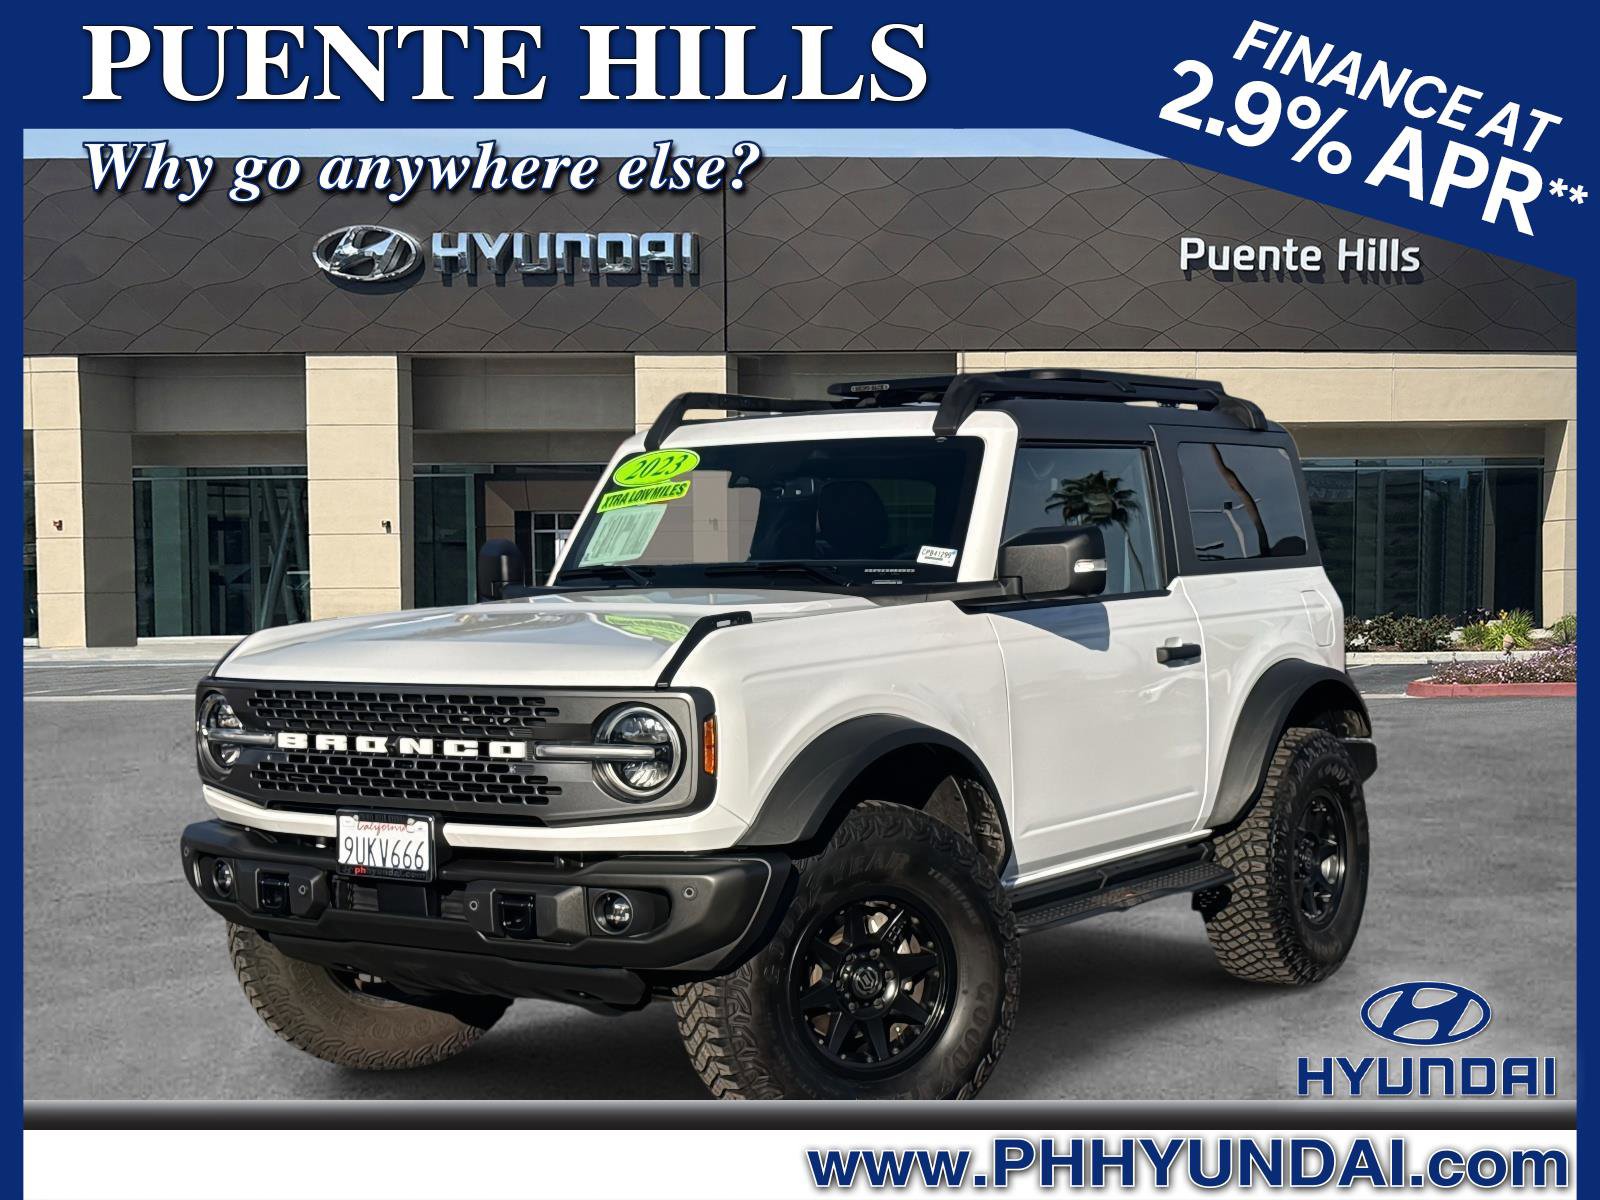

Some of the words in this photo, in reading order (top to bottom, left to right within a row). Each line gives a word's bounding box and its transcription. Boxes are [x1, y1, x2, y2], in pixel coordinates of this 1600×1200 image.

[431, 231, 701, 274] HYUNDAI
[1180, 236, 1322, 273] Puente
[1338, 237, 1421, 273] Hills
[624, 453, 690, 481] 2023
[601, 493, 627, 510] XTRA
[626, 488, 651, 504] LOW
[650, 482, 688, 500] MILES
[277, 732, 526, 759] BRONCO
[344, 836, 425, 869] 9UKV666
